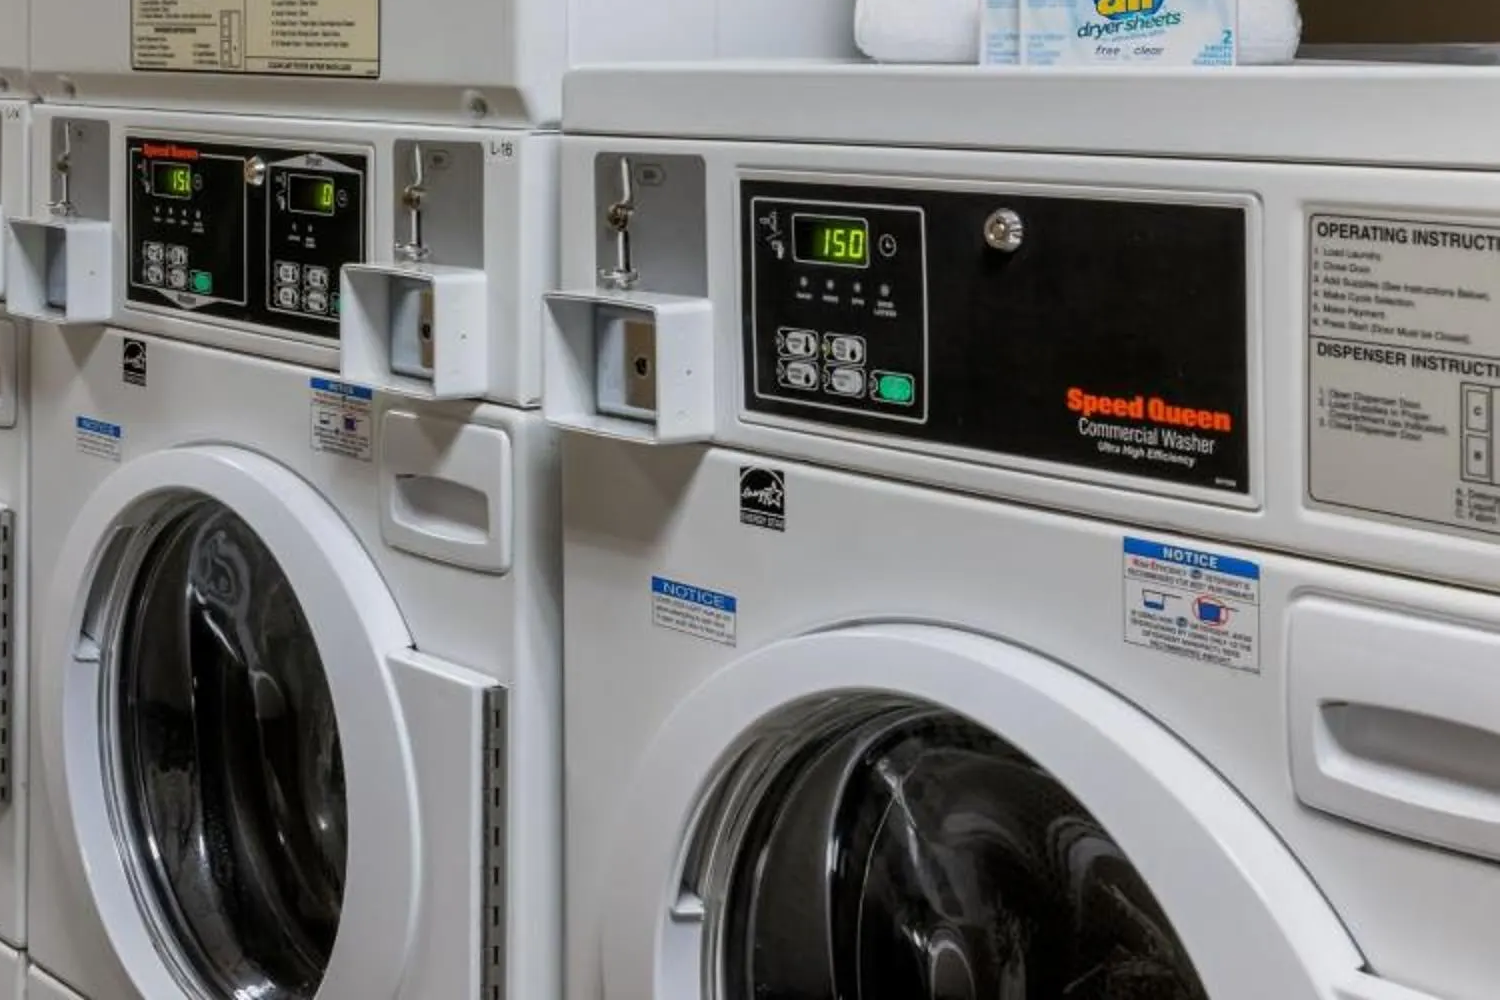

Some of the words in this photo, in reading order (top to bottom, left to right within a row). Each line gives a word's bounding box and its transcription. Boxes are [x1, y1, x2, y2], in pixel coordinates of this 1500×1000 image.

[1077, 21, 1123, 40] dryer
[1123, 12, 1181, 31] sheets
[823, 228, 865, 259] 150
[1317, 221, 1408, 245] OPERATING
[1317, 342, 1407, 368] DISPENSER
[1066, 386, 1145, 419] Speed
[1148, 398, 1231, 432] Queen
[1473, 405, 1483, 417] C
[1077, 416, 1159, 446] Commercial
[1161, 428, 1216, 455] Washer
[1122, 444, 1145, 459] High
[1147, 447, 1197, 469] Efficiency
[1163, 547, 1219, 569] NOTICE
[662, 582, 725, 609] NOTICE
